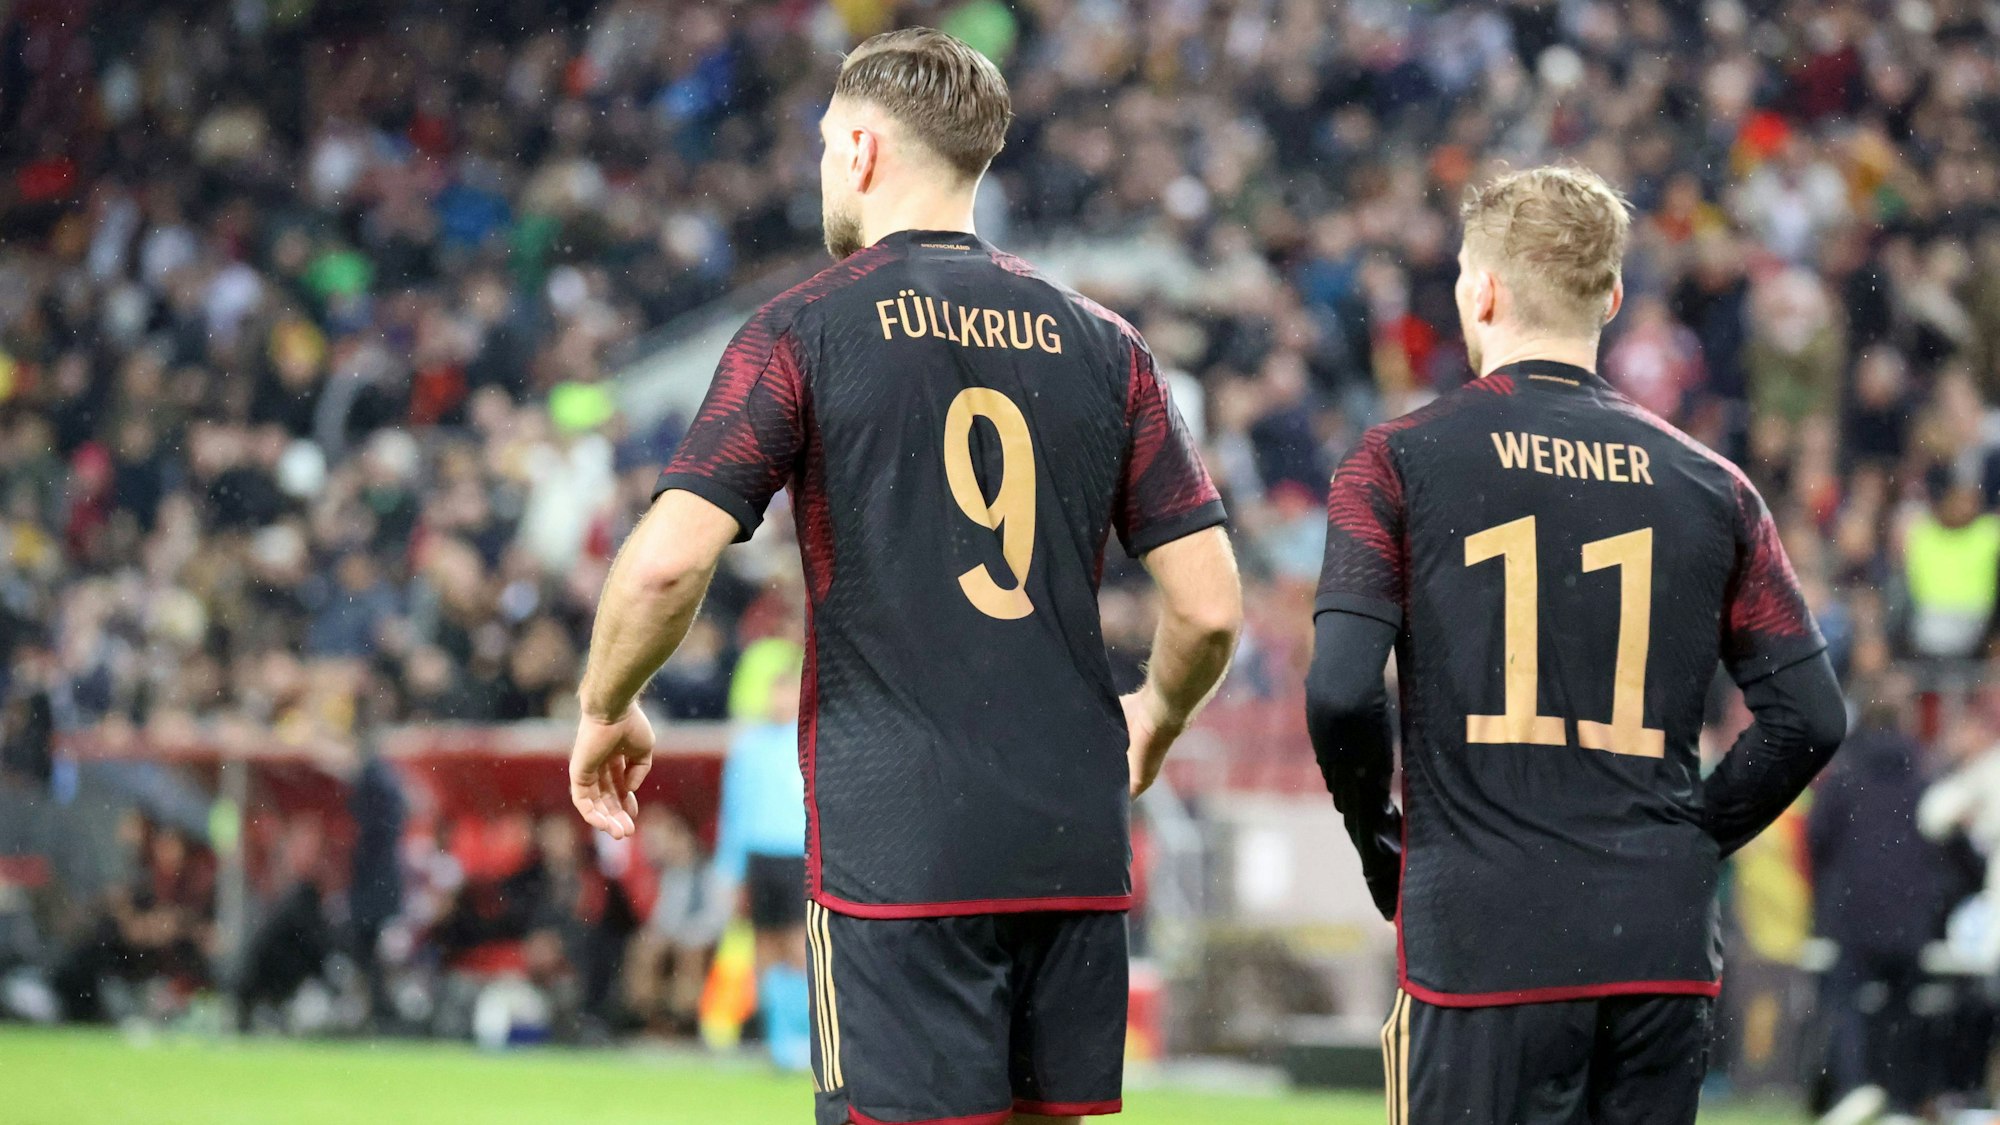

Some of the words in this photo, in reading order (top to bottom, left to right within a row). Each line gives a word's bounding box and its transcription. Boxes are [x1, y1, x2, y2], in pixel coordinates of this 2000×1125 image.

[876, 289, 1062, 354] FÜLLKRUG
[943, 387, 1036, 620] 9
[1490, 431, 1654, 485] WERNER
[1464, 515, 1665, 757] 11
